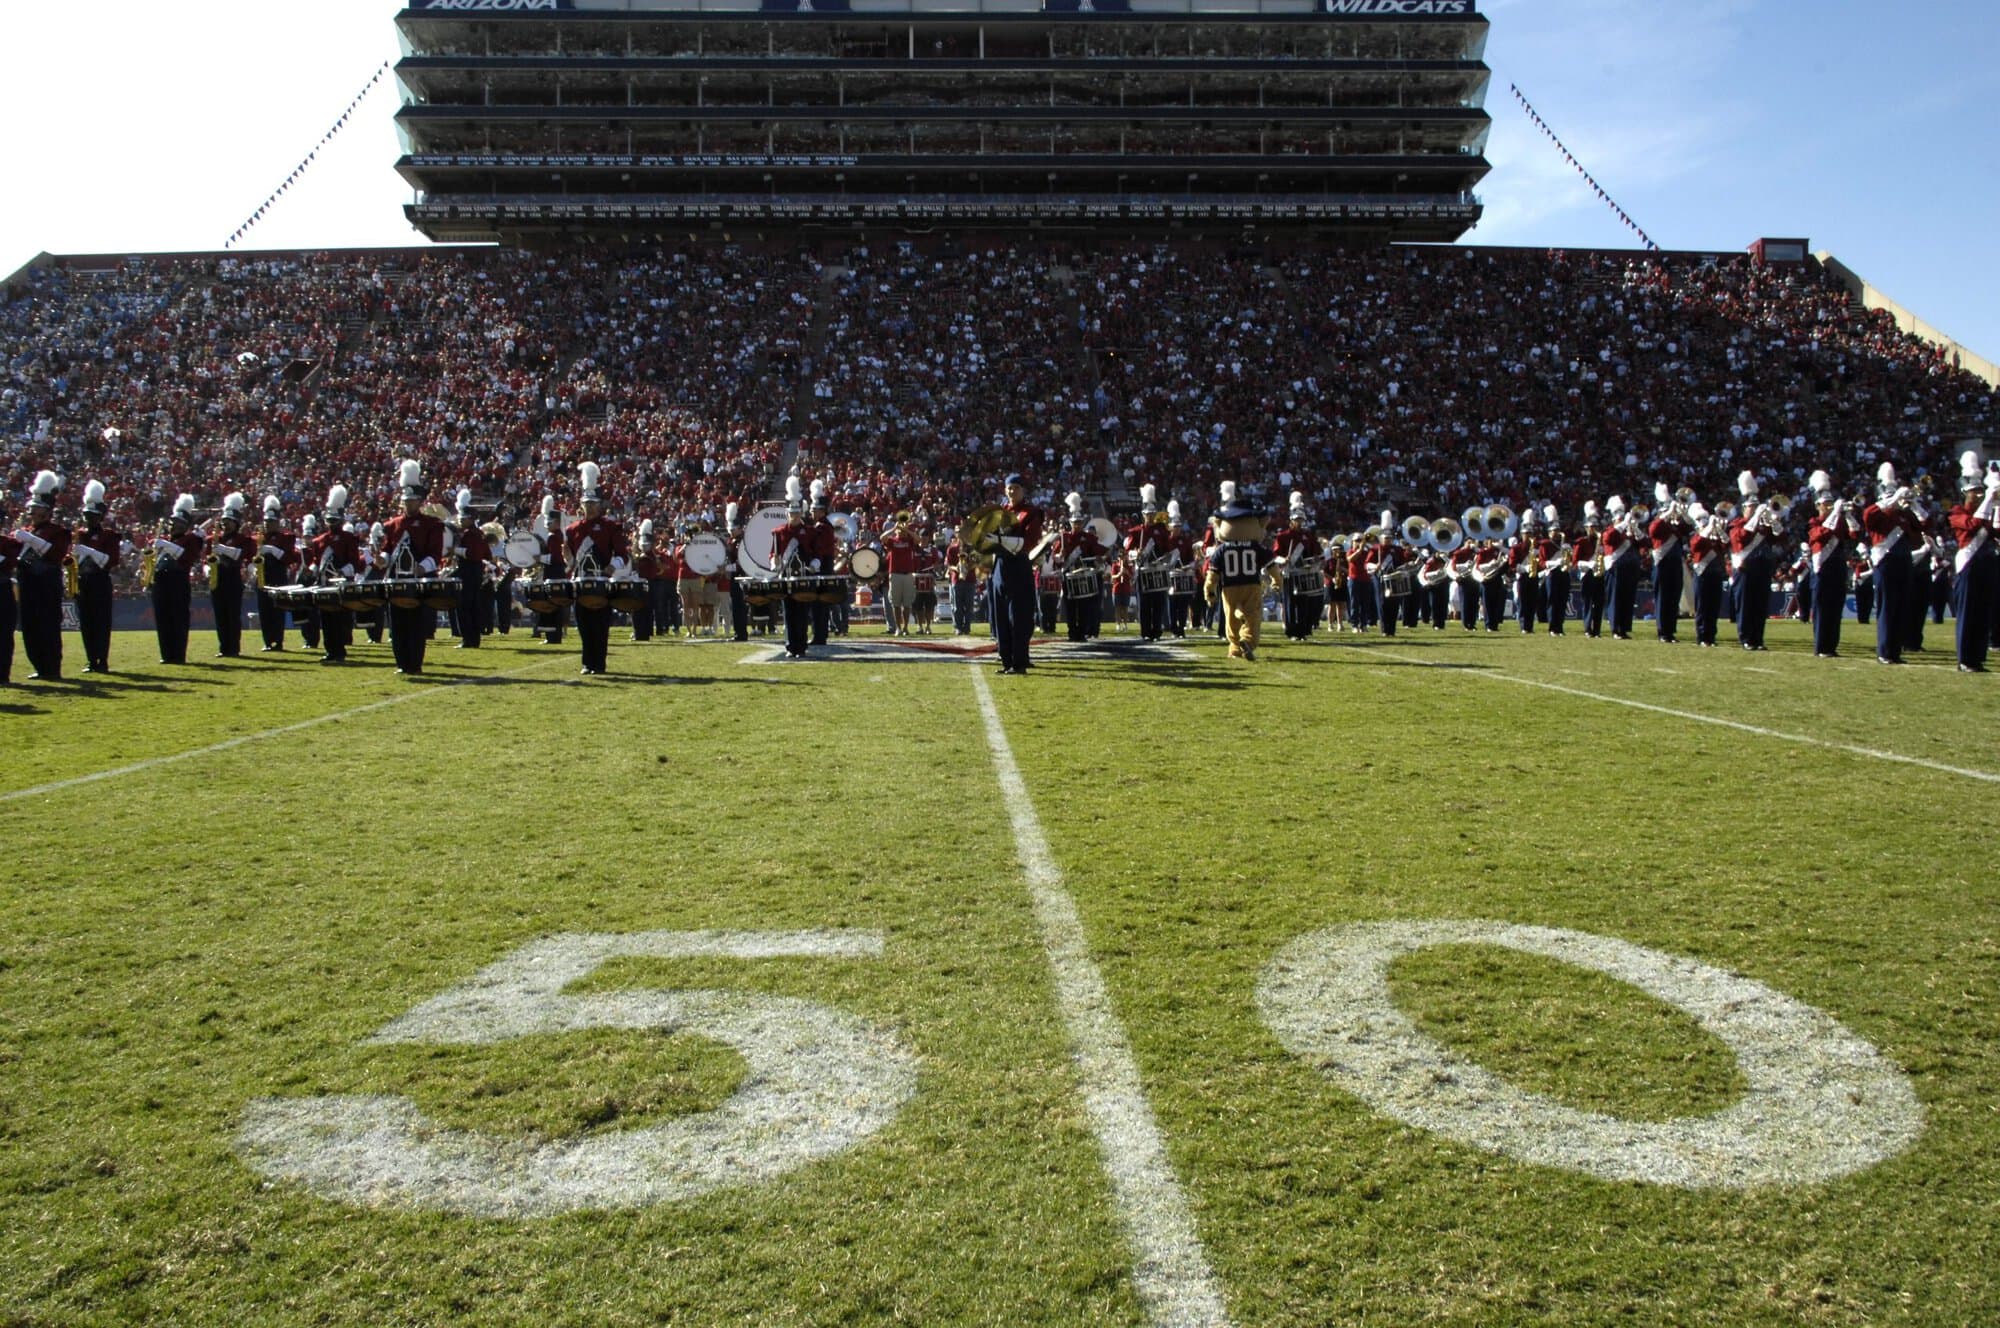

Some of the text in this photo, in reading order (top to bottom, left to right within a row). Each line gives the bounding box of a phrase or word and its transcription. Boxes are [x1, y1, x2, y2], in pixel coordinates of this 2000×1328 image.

[427, 0, 557, 10] ARIZONA
[1324, 0, 1467, 13] WILDCATS
[1224, 549, 1257, 577] 00
